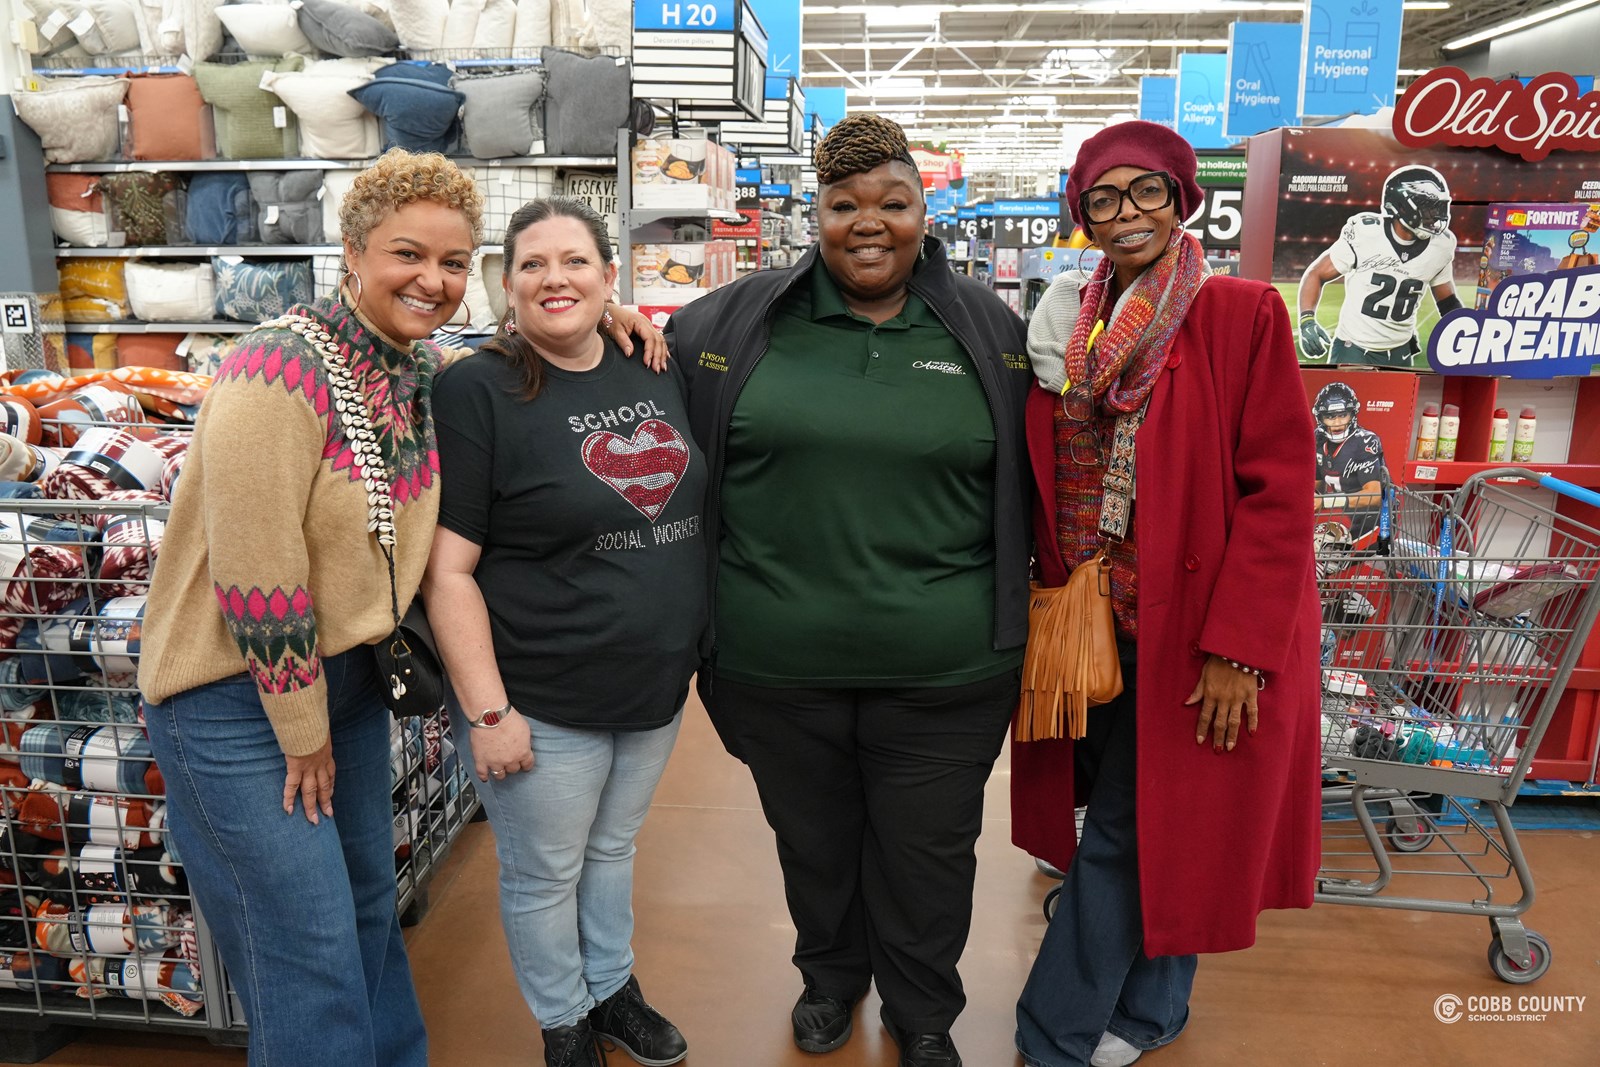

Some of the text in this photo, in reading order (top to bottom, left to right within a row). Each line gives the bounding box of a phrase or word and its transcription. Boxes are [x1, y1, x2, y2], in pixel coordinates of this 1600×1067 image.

[662, 3, 717, 26] H 20
[653, 36, 690, 45] Decorative
[1315, 45, 1372, 60] Personal
[1314, 62, 1369, 78] Hygiene
[1236, 79, 1261, 90] Oral
[1235, 92, 1280, 106] Hygiene
[1183, 102, 1214, 114] Cough
[1405, 77, 1513, 137] Old
[1183, 113, 1216, 125] Allergy
[1207, 161, 1241, 170] holidays
[1292, 176, 1346, 184] SAQUON BARKLEY
[1318, 184, 1332, 192] EAGLES
[599, 196, 618, 213] THE
[999, 205, 1023, 213] Everyday
[1526, 210, 1580, 225] FORTNITE
[1361, 271, 1424, 322] 26
[1497, 272, 1600, 319] GRAB
[1436, 316, 1600, 367] GREATN
[912, 360, 963, 372] Austell
[568, 400, 666, 433] SCHOOL
[595, 515, 700, 551] SOCIAL WORKER
